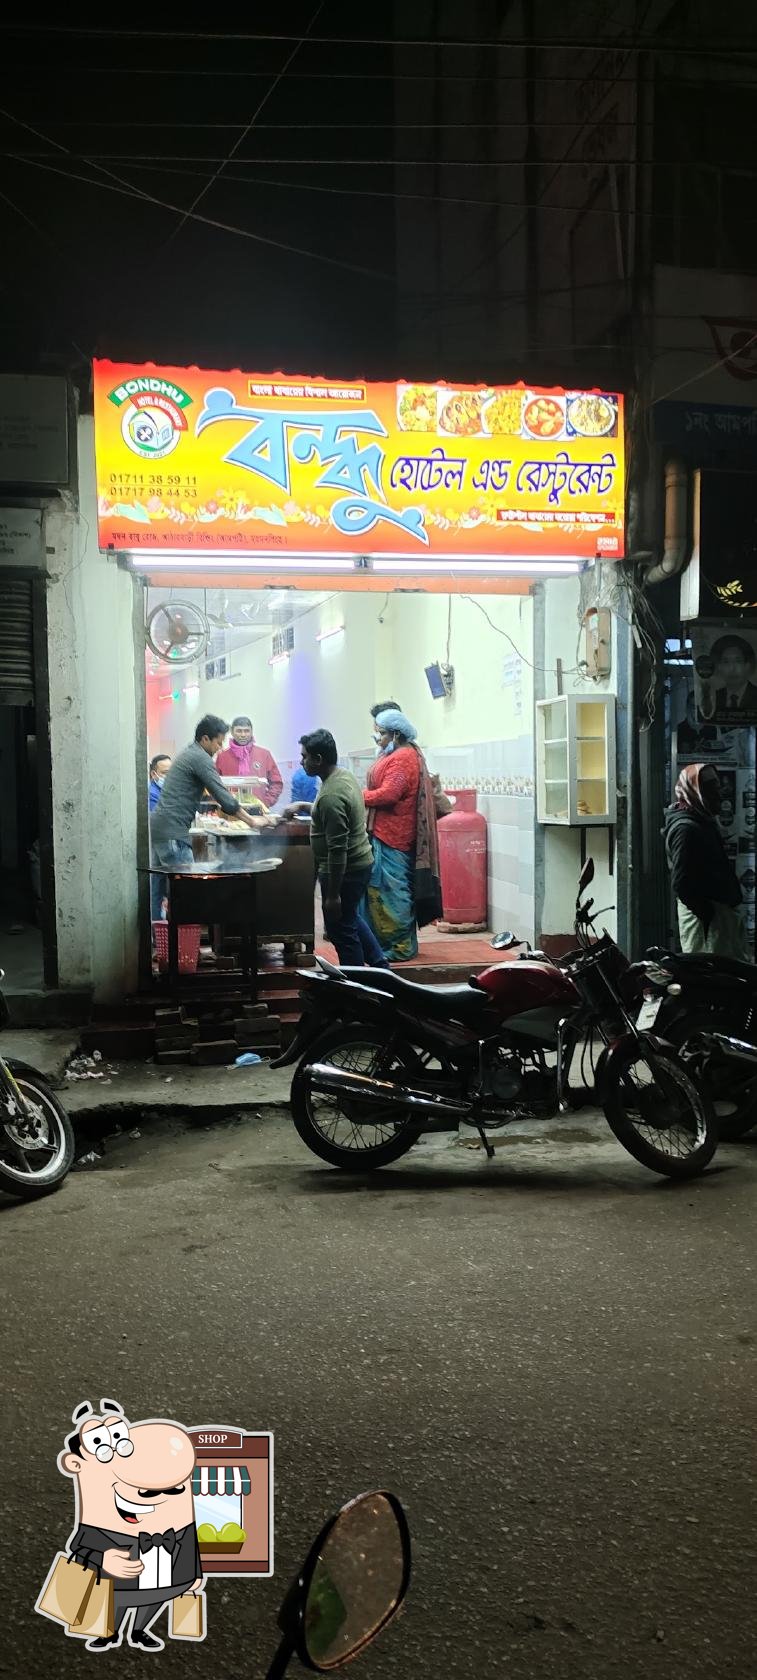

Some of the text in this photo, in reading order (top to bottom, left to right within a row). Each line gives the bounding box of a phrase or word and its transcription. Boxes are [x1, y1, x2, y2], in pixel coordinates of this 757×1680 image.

[114, 379, 184, 404] BONDHU
[137, 396, 154, 406] HOTEL
[196, 387, 430, 546] বন্ধু
[110, 473, 197, 485] 01711 38 59 11
[390, 447, 467, 492] হোটেল
[516, 452, 616, 505] রেস্টুরেন্ট
[110, 487, 145, 496] 01717
[167, 488, 180, 497] 44
[184, 488, 197, 498] 53
